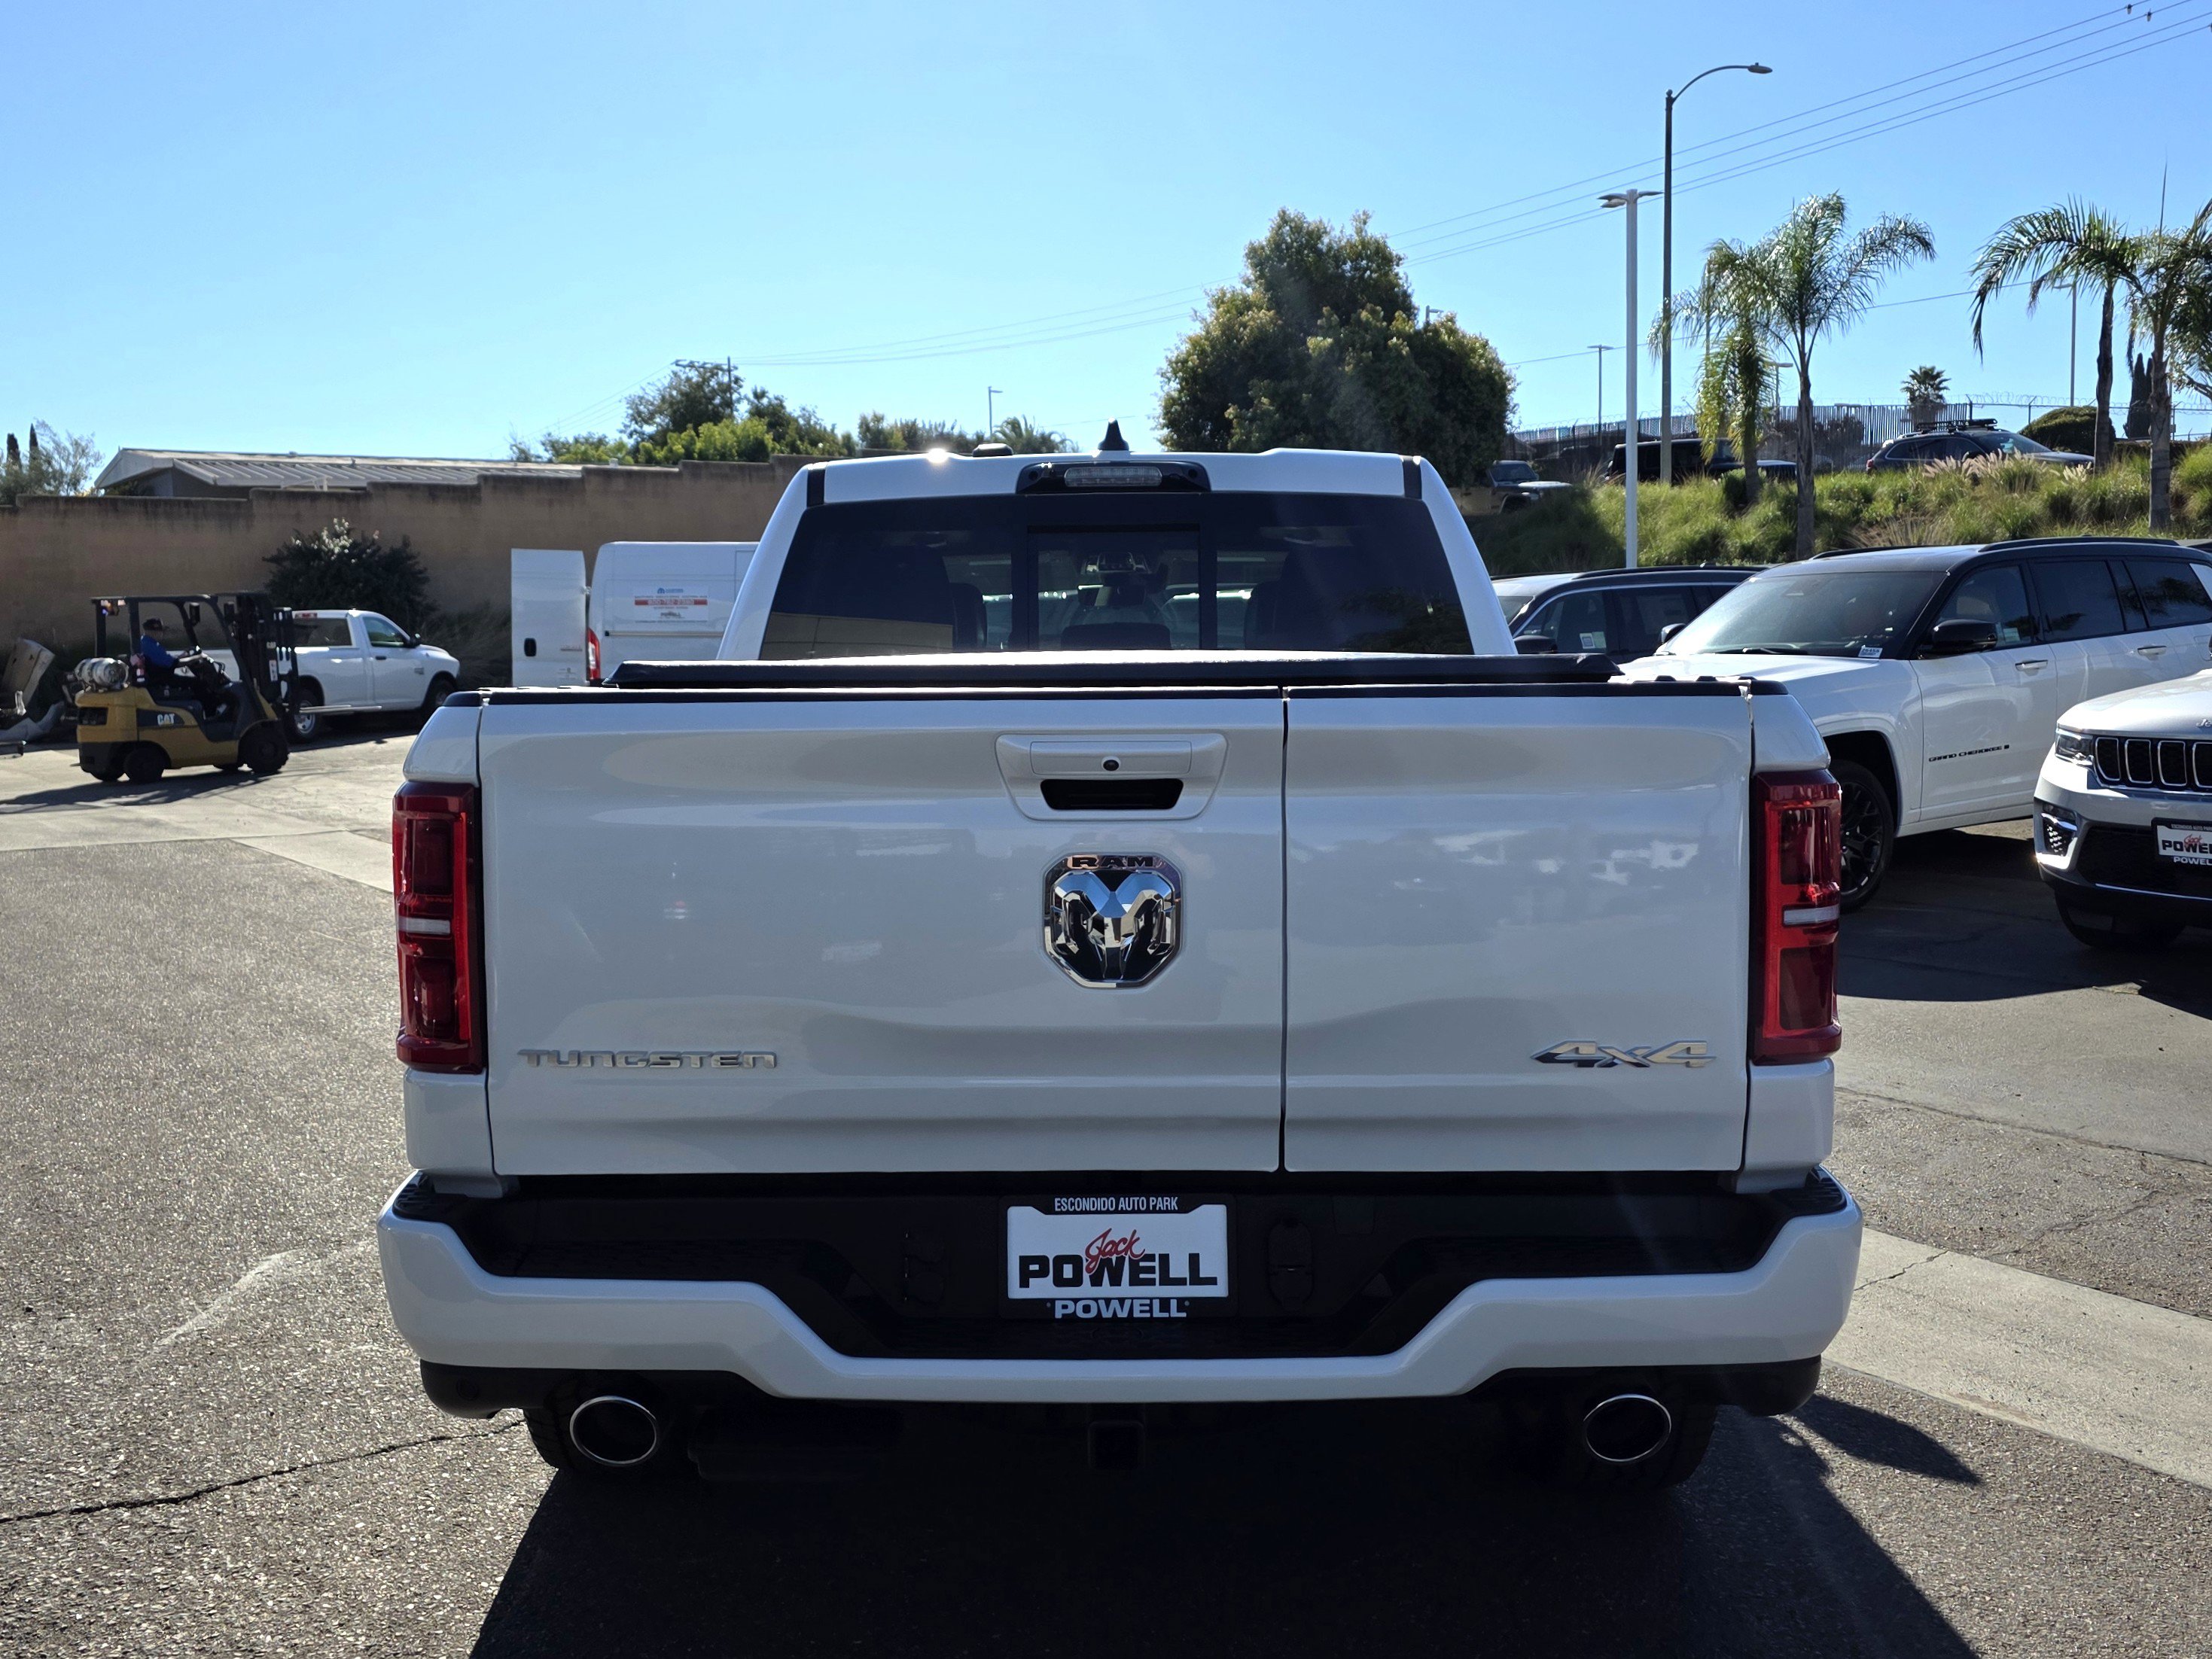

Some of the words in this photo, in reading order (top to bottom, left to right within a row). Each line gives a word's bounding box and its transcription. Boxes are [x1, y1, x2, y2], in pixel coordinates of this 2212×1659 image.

[157, 713, 175, 726] CAT
[1928, 753, 1957, 763] GRAND
[1958, 745, 2003, 757] CHEROKEE
[1071, 857, 1153, 867] RAM
[518, 1049, 777, 1068] TUNGSTEN
[1054, 1196, 1116, 1212] ESCONDIDO
[1118, 1196, 1147, 1211] AUTO
[1150, 1196, 1178, 1211] PARK
[1085, 1228, 1146, 1275] Jack
[1019, 1253, 1218, 1289] POWELL
[1055, 1298, 1187, 1319] POWELL
